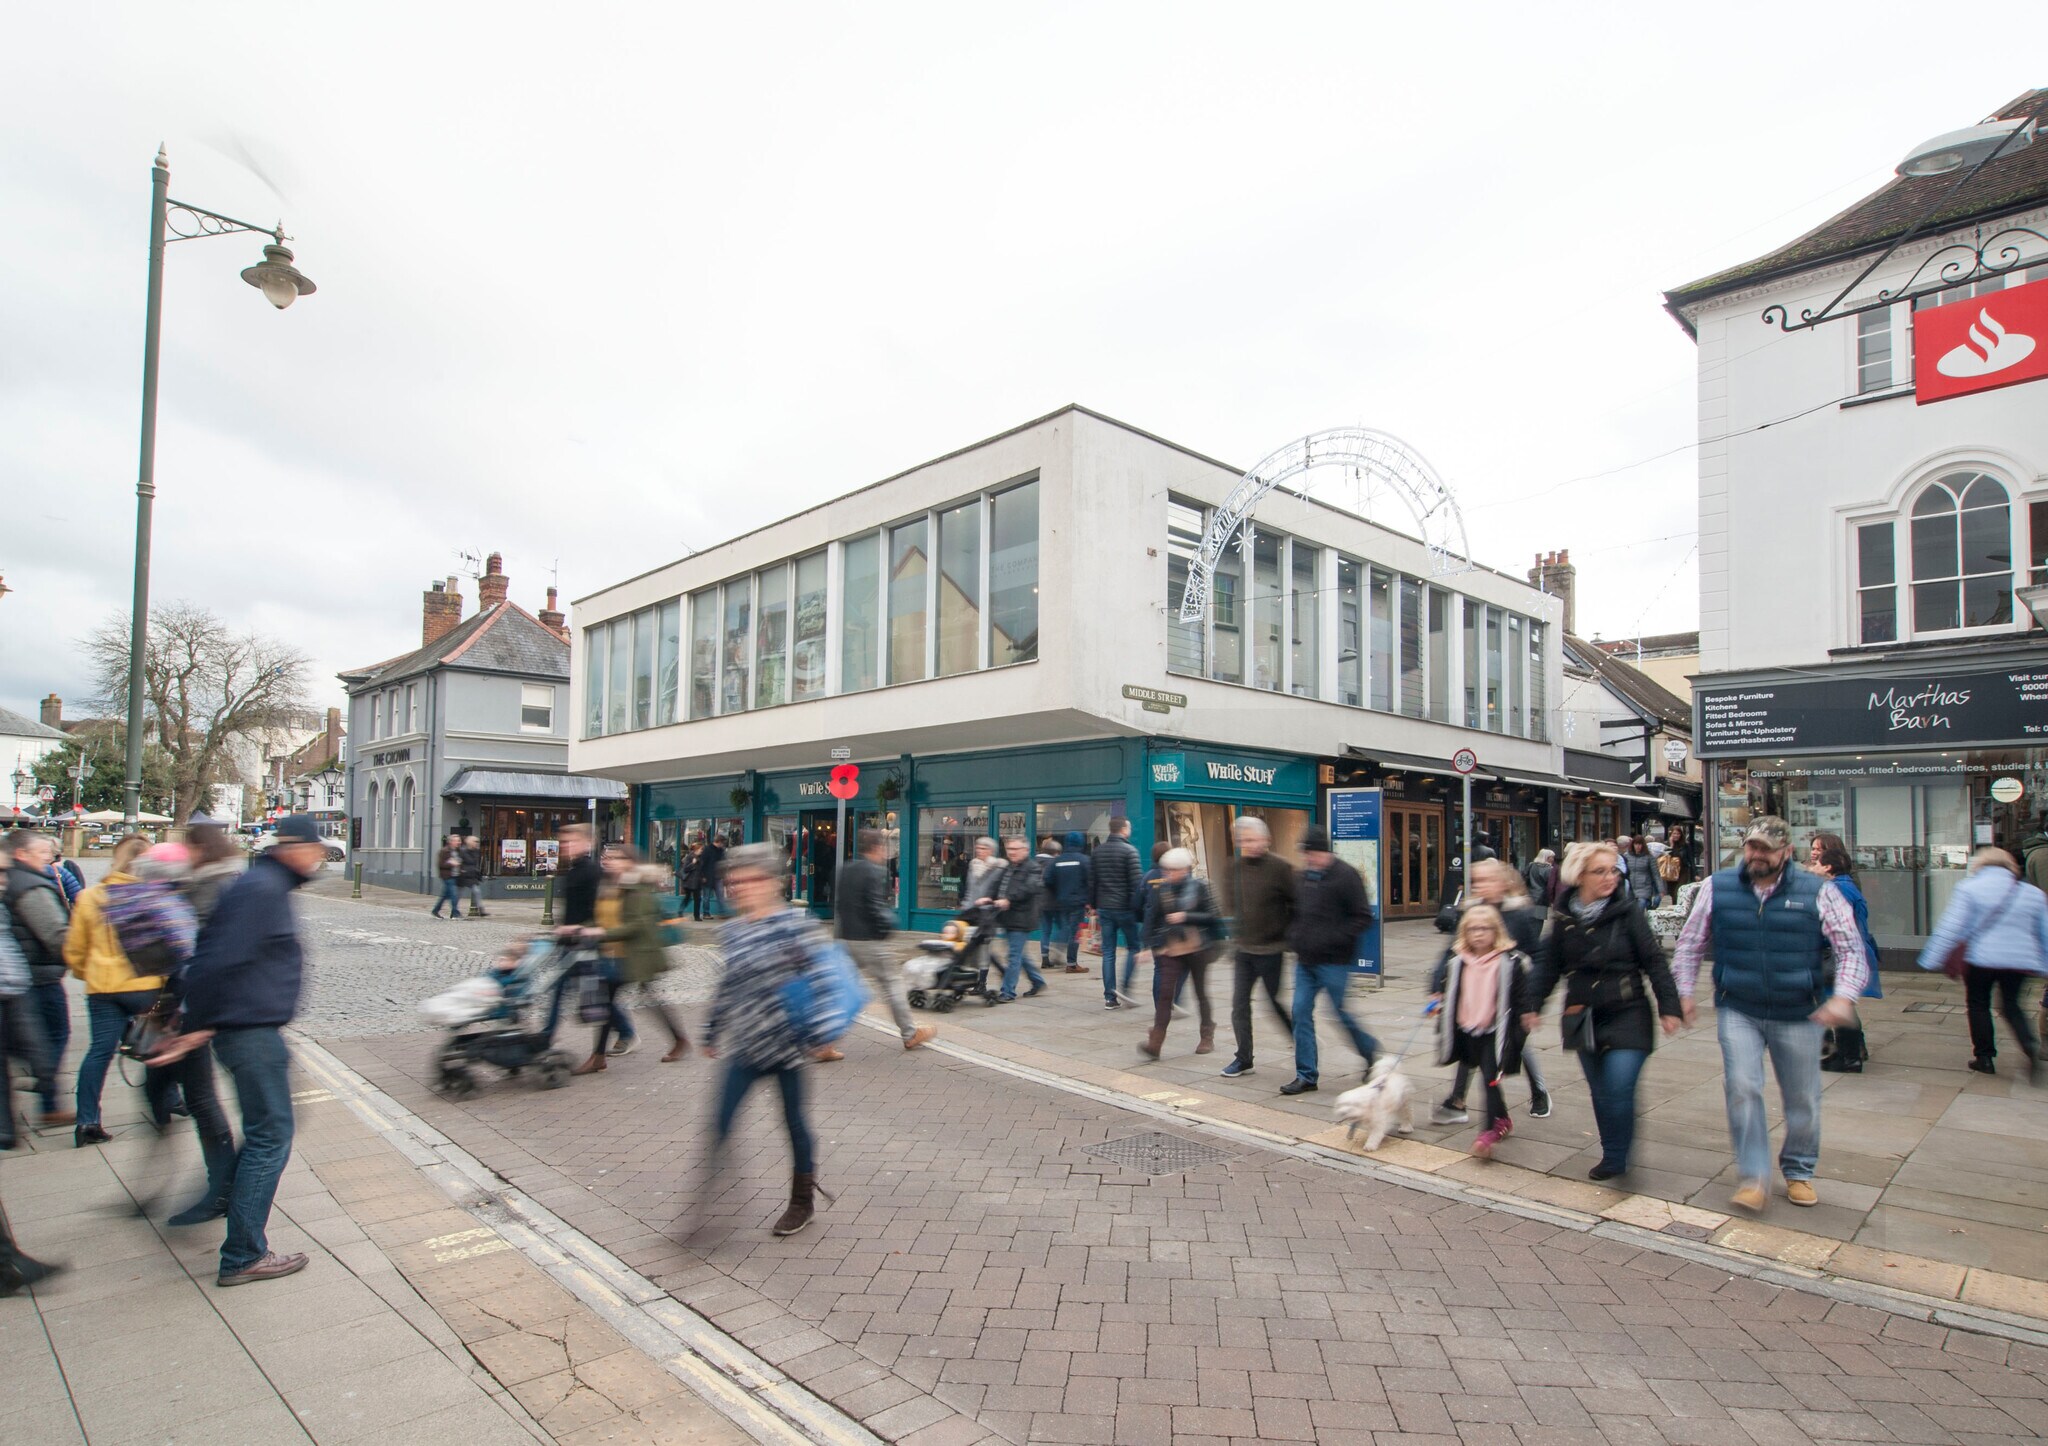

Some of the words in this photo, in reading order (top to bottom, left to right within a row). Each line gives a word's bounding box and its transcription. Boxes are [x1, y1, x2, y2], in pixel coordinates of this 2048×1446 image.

[1326, 431, 1440, 502] STREET
[2008, 674, 2030, 682] Visit
[1129, 687, 1156, 700] MIDDLE
[1158, 692, 1183, 704] STREET
[1705, 695, 1737, 703] Bespoke
[1739, 692, 1774, 701] Furniture
[1868, 683, 1971, 710] Marthas
[2020, 693, 2048, 701] Whea
[1705, 712, 1727, 720] Fitted
[1728, 710, 1768, 719] Bedrooms
[1889, 708, 1951, 731] Barn
[1705, 721, 1727, 729] Sofas
[2024, 725, 2041, 733] Tel:
[1705, 729, 1739, 737] Furniture
[1741, 727, 1797, 736] Re-Upholstery
[1705, 735, 1794, 746] www.marthasbarn.com
[373, 752, 385, 767] THE
[386, 748, 411, 765] CROWN
[1751, 770, 1785, 778] Custom
[1786, 769, 1812, 777] made
[1813, 768, 1836, 776] solid
[1869, 766, 1894, 774] fitted
[1991, 762, 2031, 771] studies
[2034, 762, 2043, 770] &
